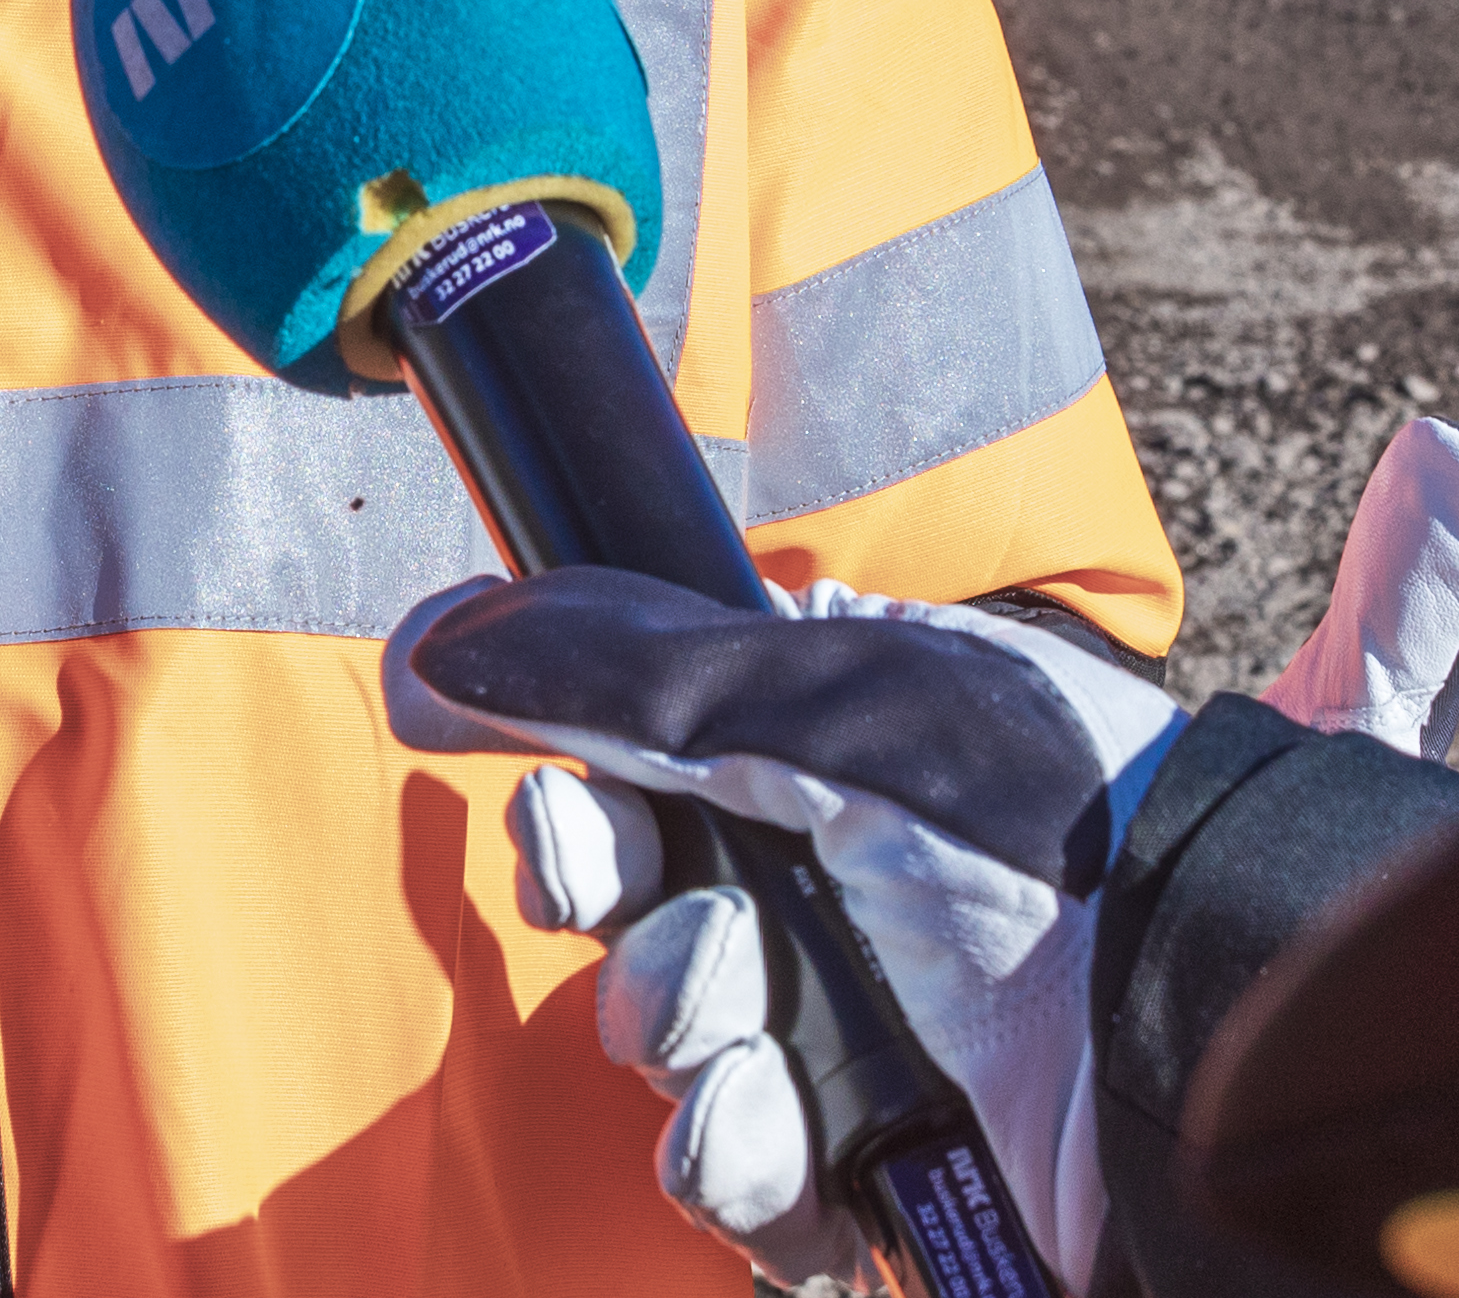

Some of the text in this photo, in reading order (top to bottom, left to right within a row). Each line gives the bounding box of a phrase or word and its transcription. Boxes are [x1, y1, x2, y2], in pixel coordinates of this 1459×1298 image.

[435, 239, 516, 302] 32 27 22 00
